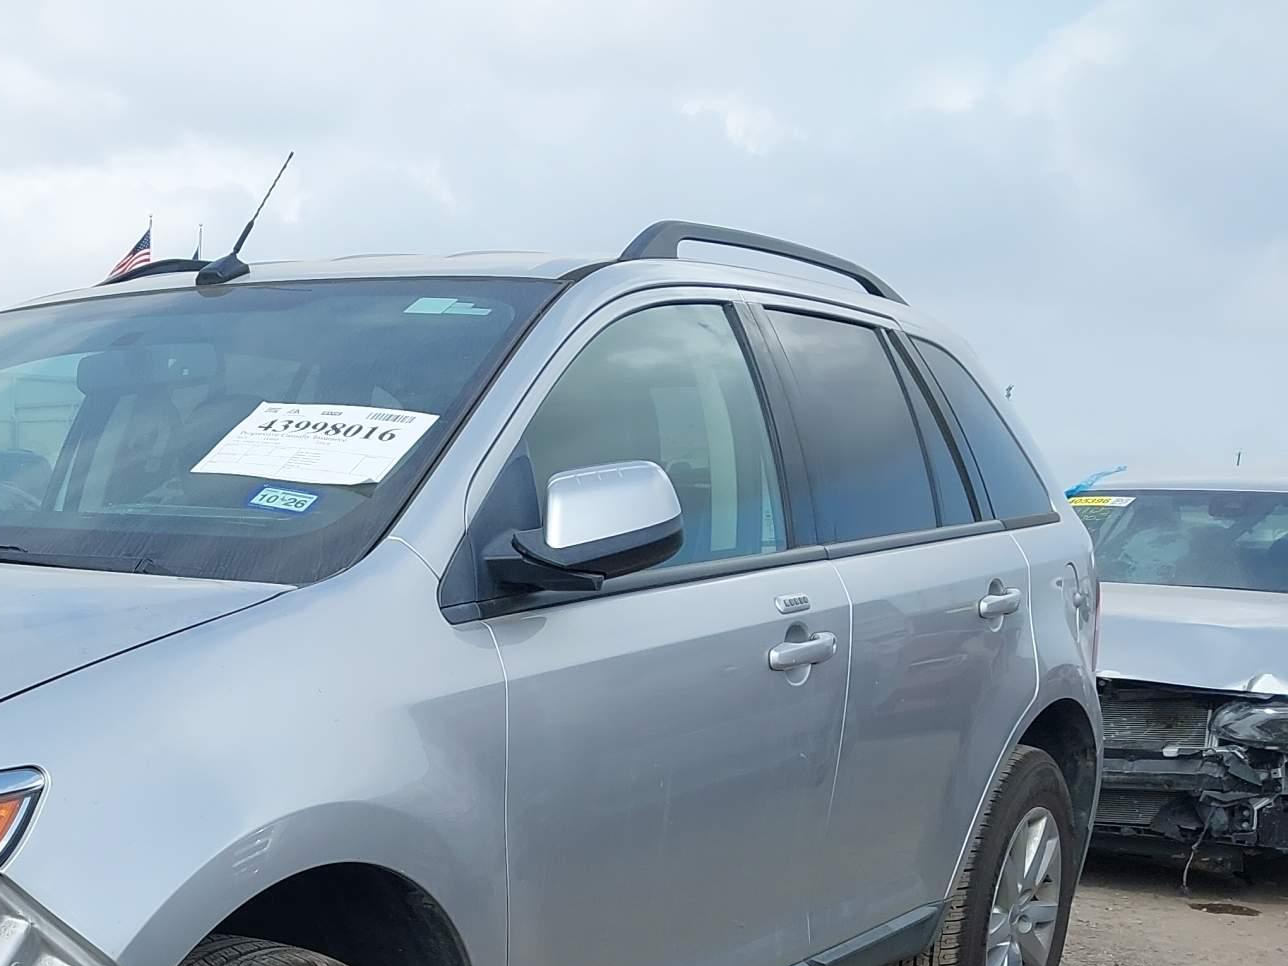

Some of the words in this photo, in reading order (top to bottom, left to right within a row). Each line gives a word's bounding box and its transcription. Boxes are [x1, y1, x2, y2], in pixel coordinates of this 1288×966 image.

[258, 418, 401, 442] 43998016
[258, 493, 280, 504] 10
[281, 497, 308, 509] 26
